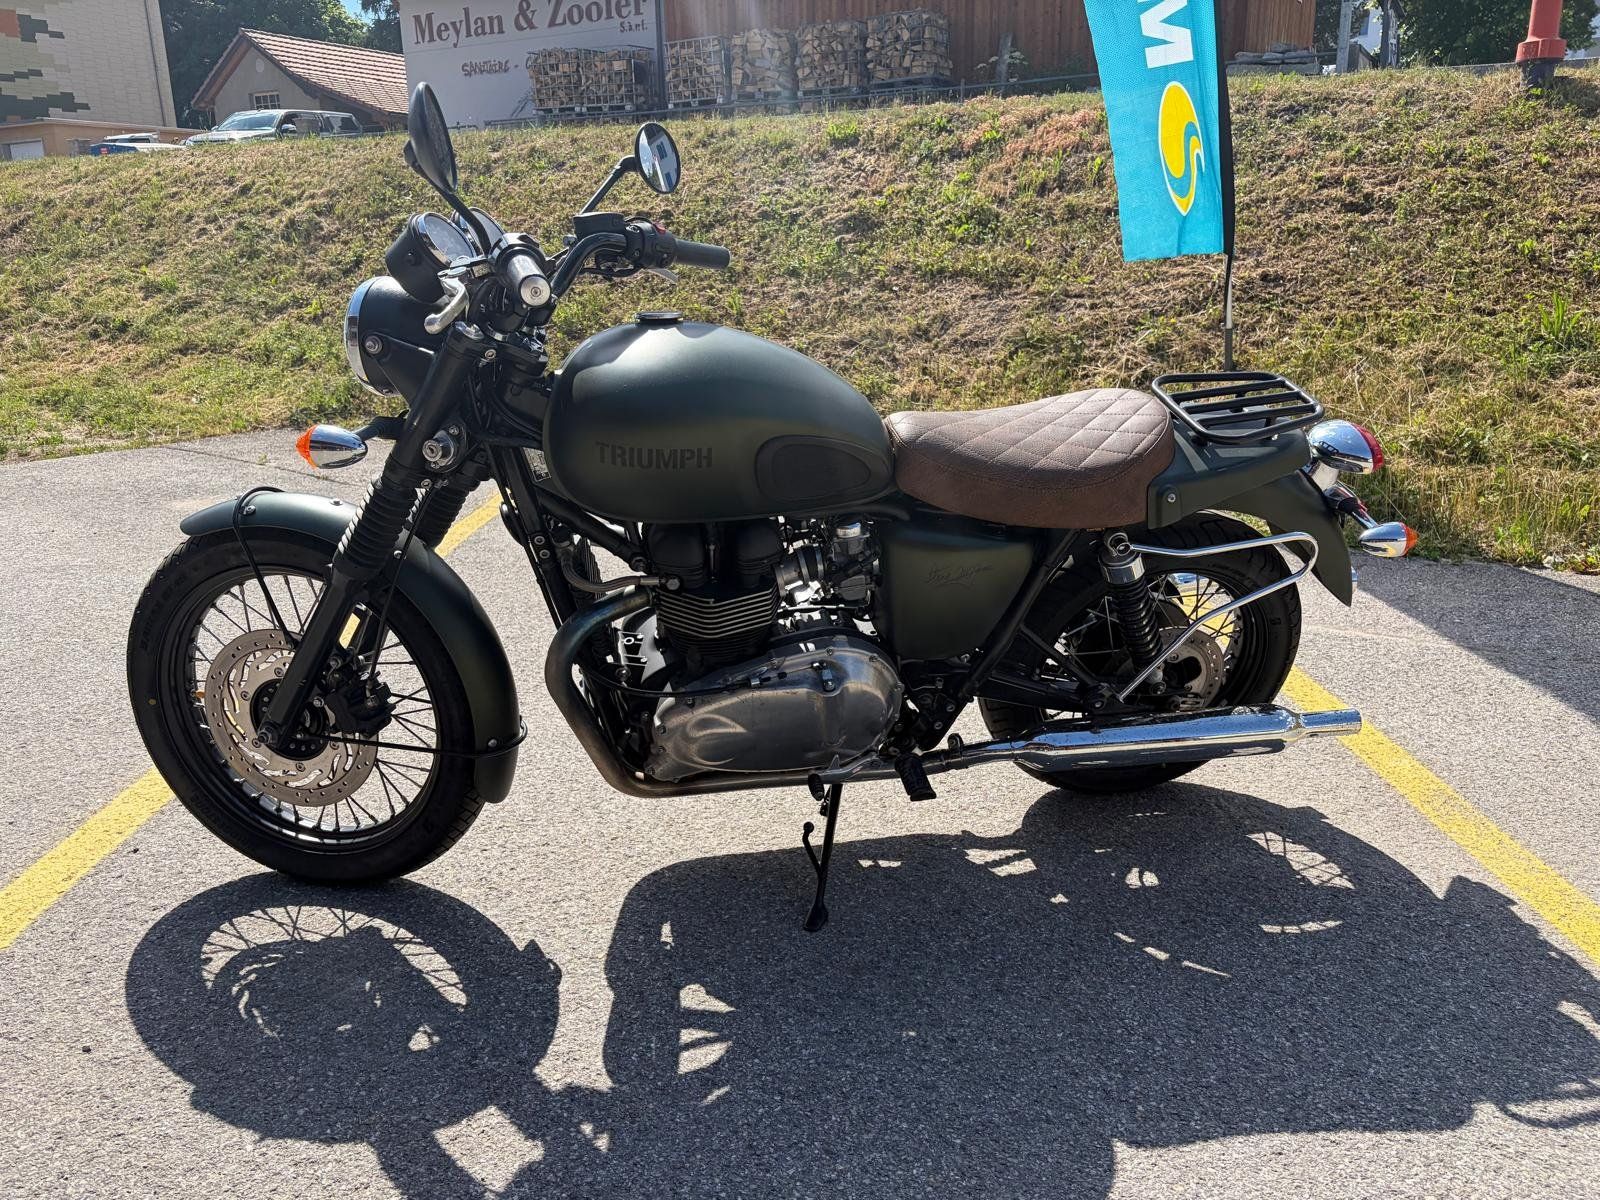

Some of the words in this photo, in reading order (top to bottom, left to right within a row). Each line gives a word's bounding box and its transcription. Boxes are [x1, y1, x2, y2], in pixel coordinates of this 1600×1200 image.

[412, 7, 505, 48] Meylan
[513, 0, 538, 31] &
[595, 441, 713, 470] TRIUMPH
